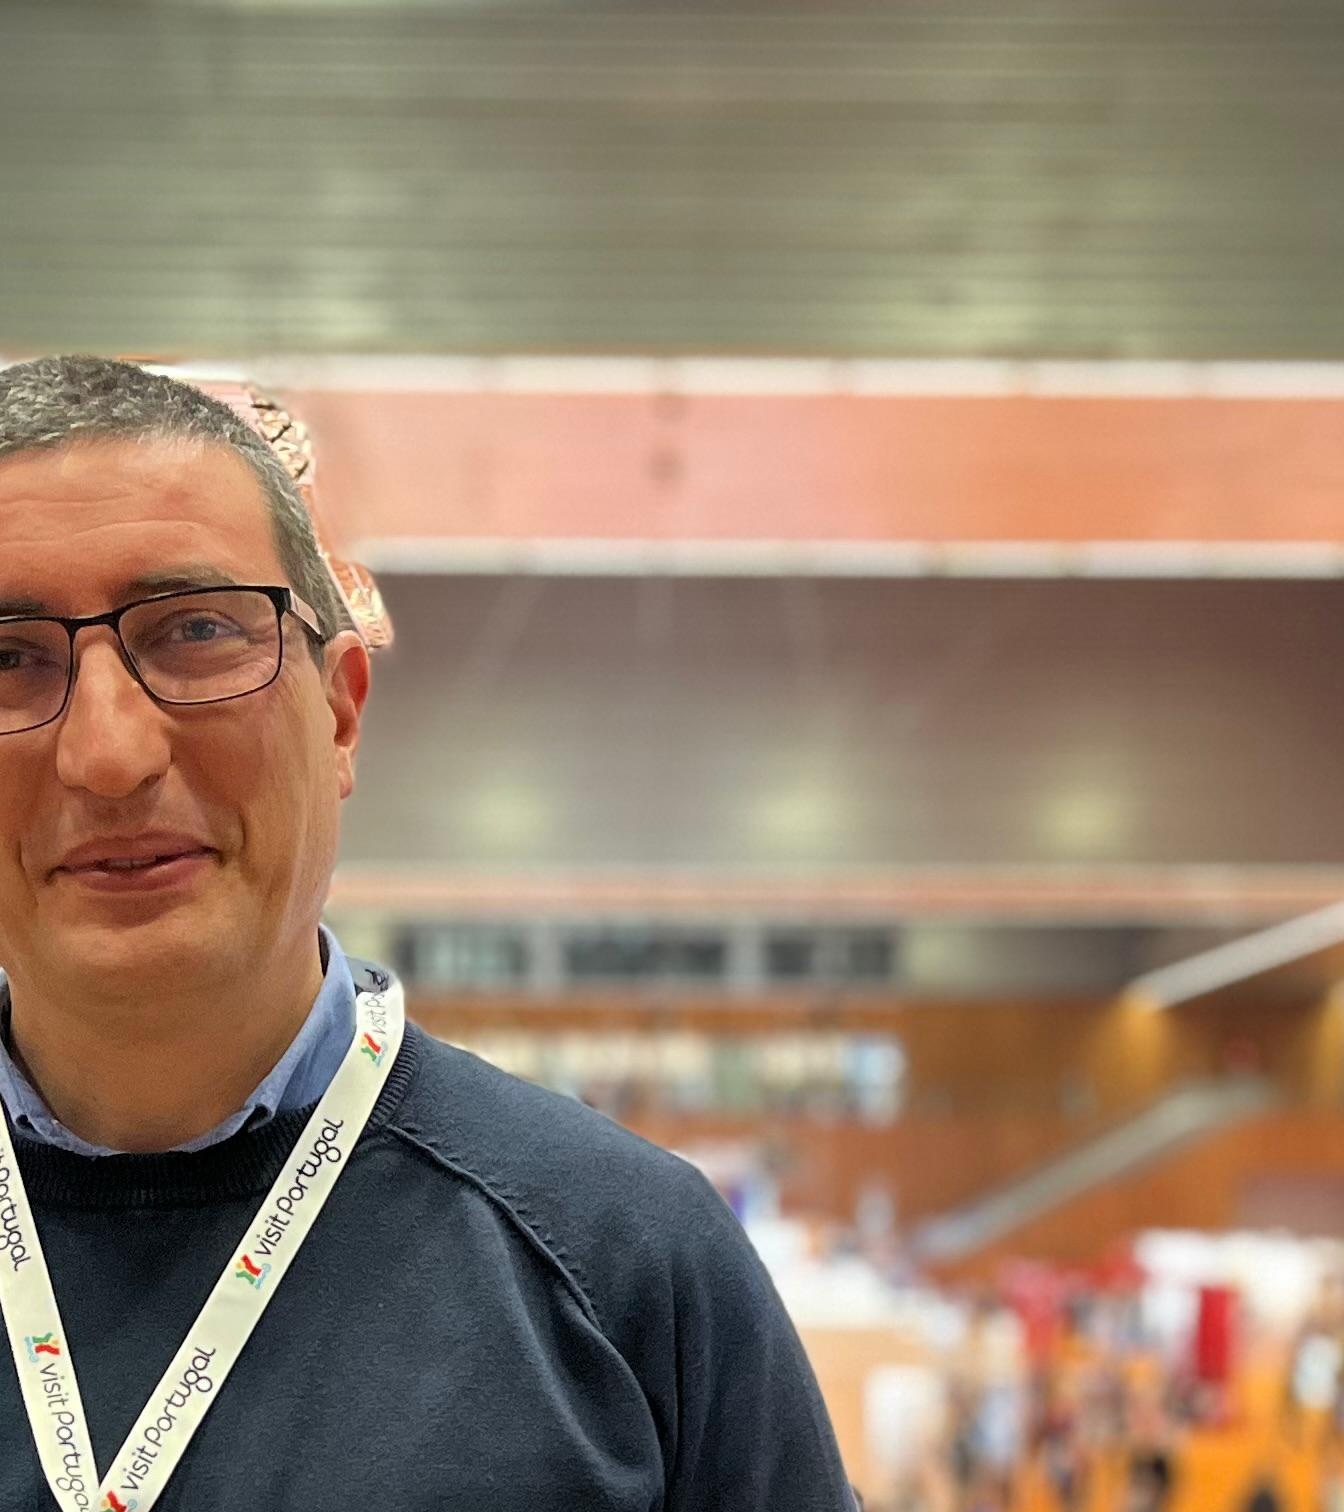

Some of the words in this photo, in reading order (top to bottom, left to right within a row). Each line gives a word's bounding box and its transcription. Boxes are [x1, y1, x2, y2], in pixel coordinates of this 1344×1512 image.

[254, 1213, 291, 1256] visit
[40, 1362, 69, 1408] visit
[120, 1445, 158, 1490] visit
